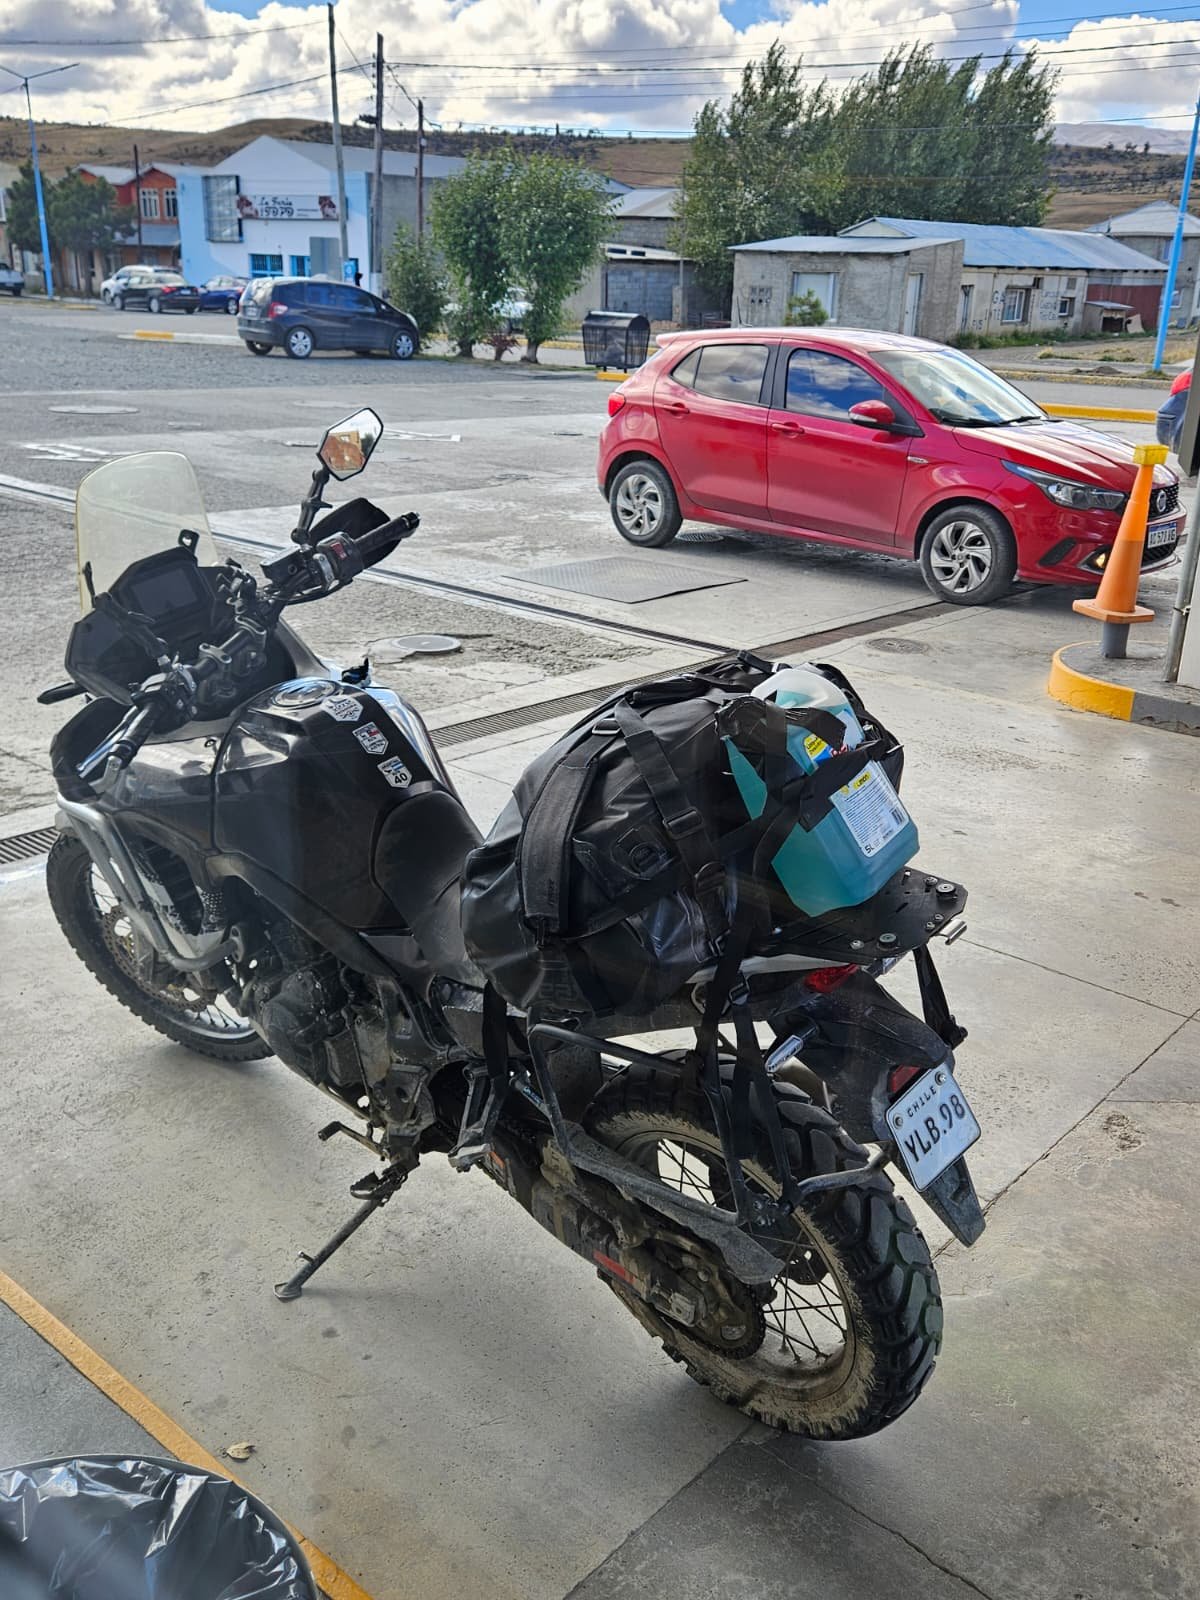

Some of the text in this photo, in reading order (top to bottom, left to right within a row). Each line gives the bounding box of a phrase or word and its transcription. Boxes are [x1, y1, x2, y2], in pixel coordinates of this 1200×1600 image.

[394, 772, 408, 785] 40
[906, 1085, 937, 1118] CHILE
[903, 1094, 965, 1162] YLB.98
